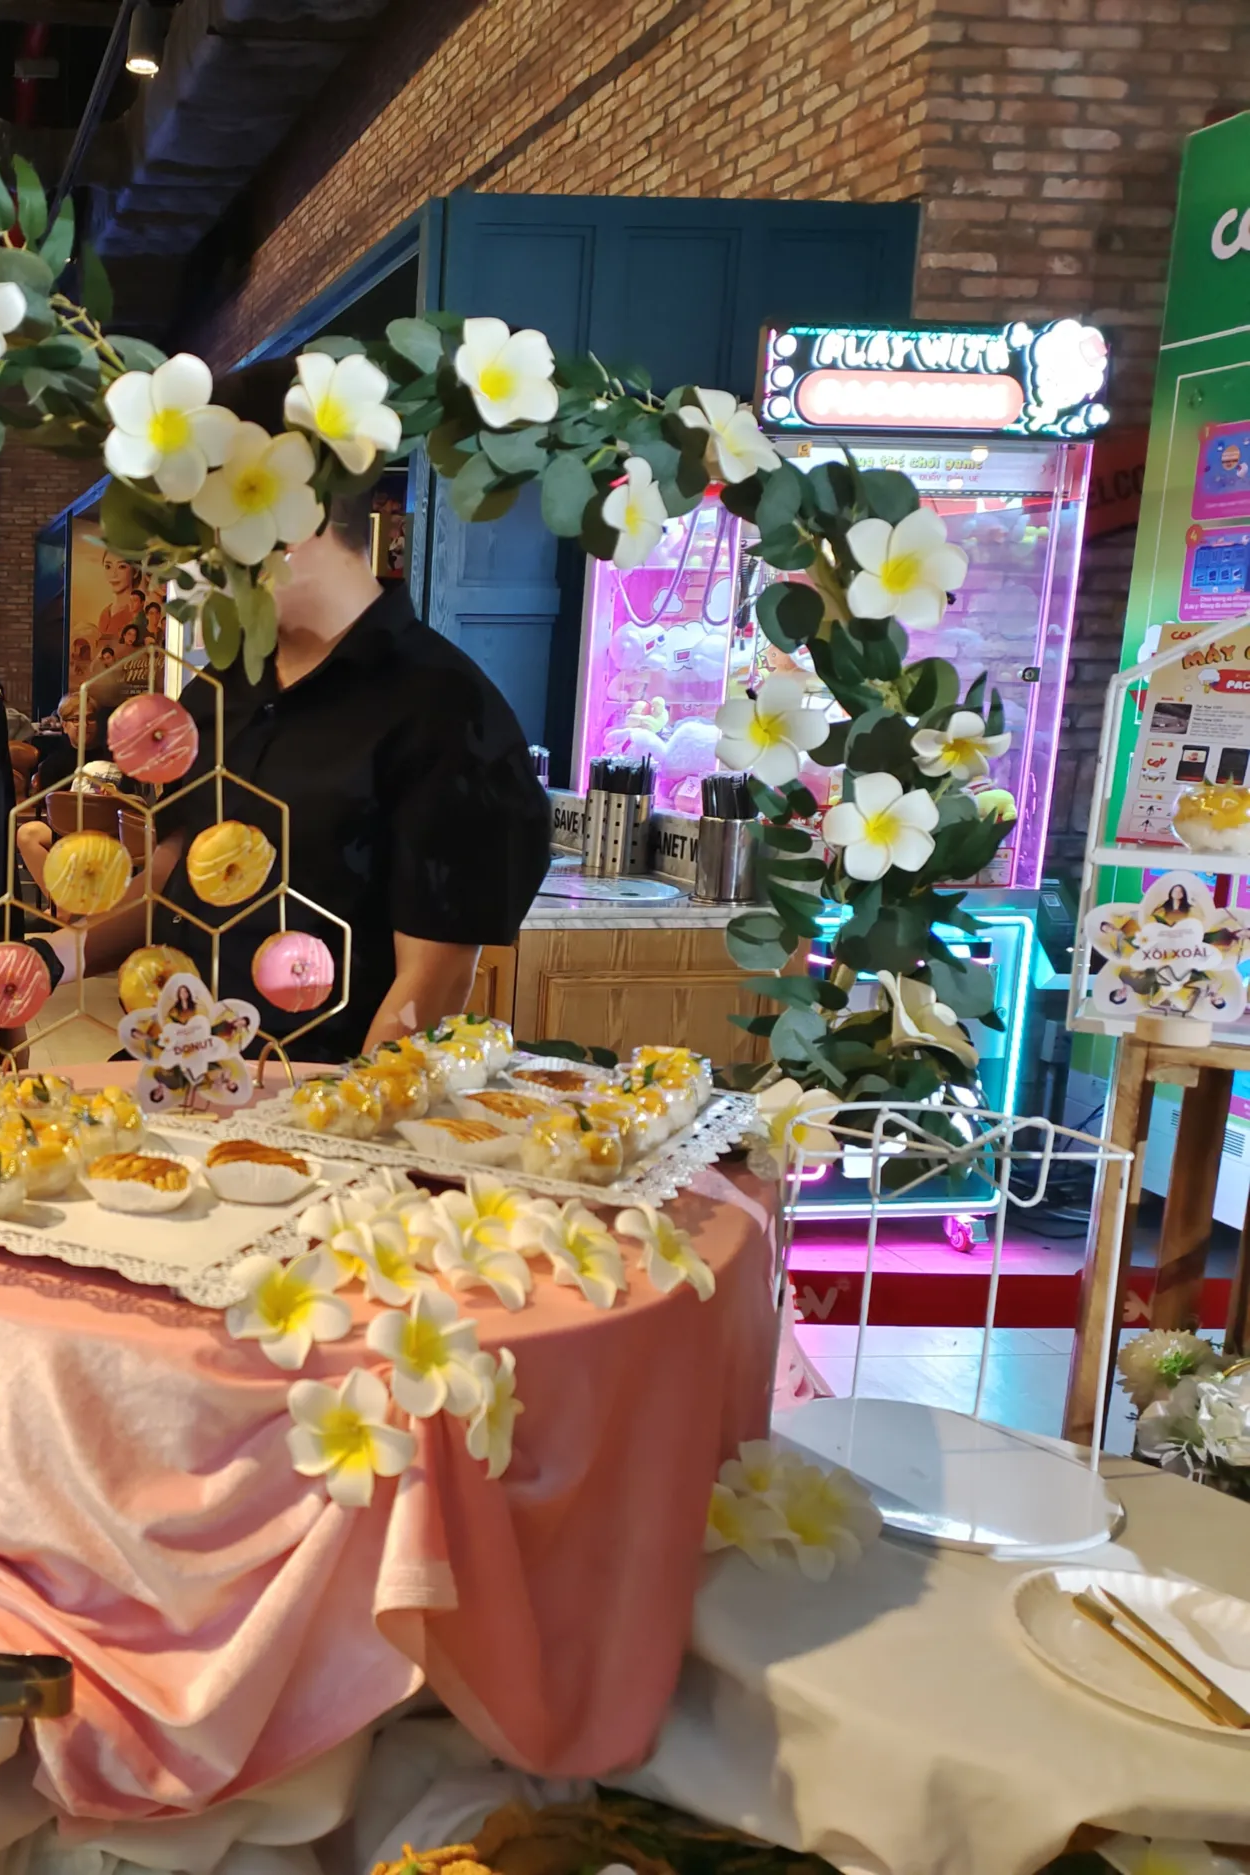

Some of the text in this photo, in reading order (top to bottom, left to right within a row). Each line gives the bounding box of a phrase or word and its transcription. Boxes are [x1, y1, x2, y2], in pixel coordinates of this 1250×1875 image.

[813, 332, 1011, 374] PLAY WITH
[1182, 642, 1236, 670] MÁY
[554, 807, 579, 834] SAVE
[656, 831, 688, 861] ANET
[1142, 948, 1168, 961] XÔI
[173, 1037, 214, 1055] DONUT
